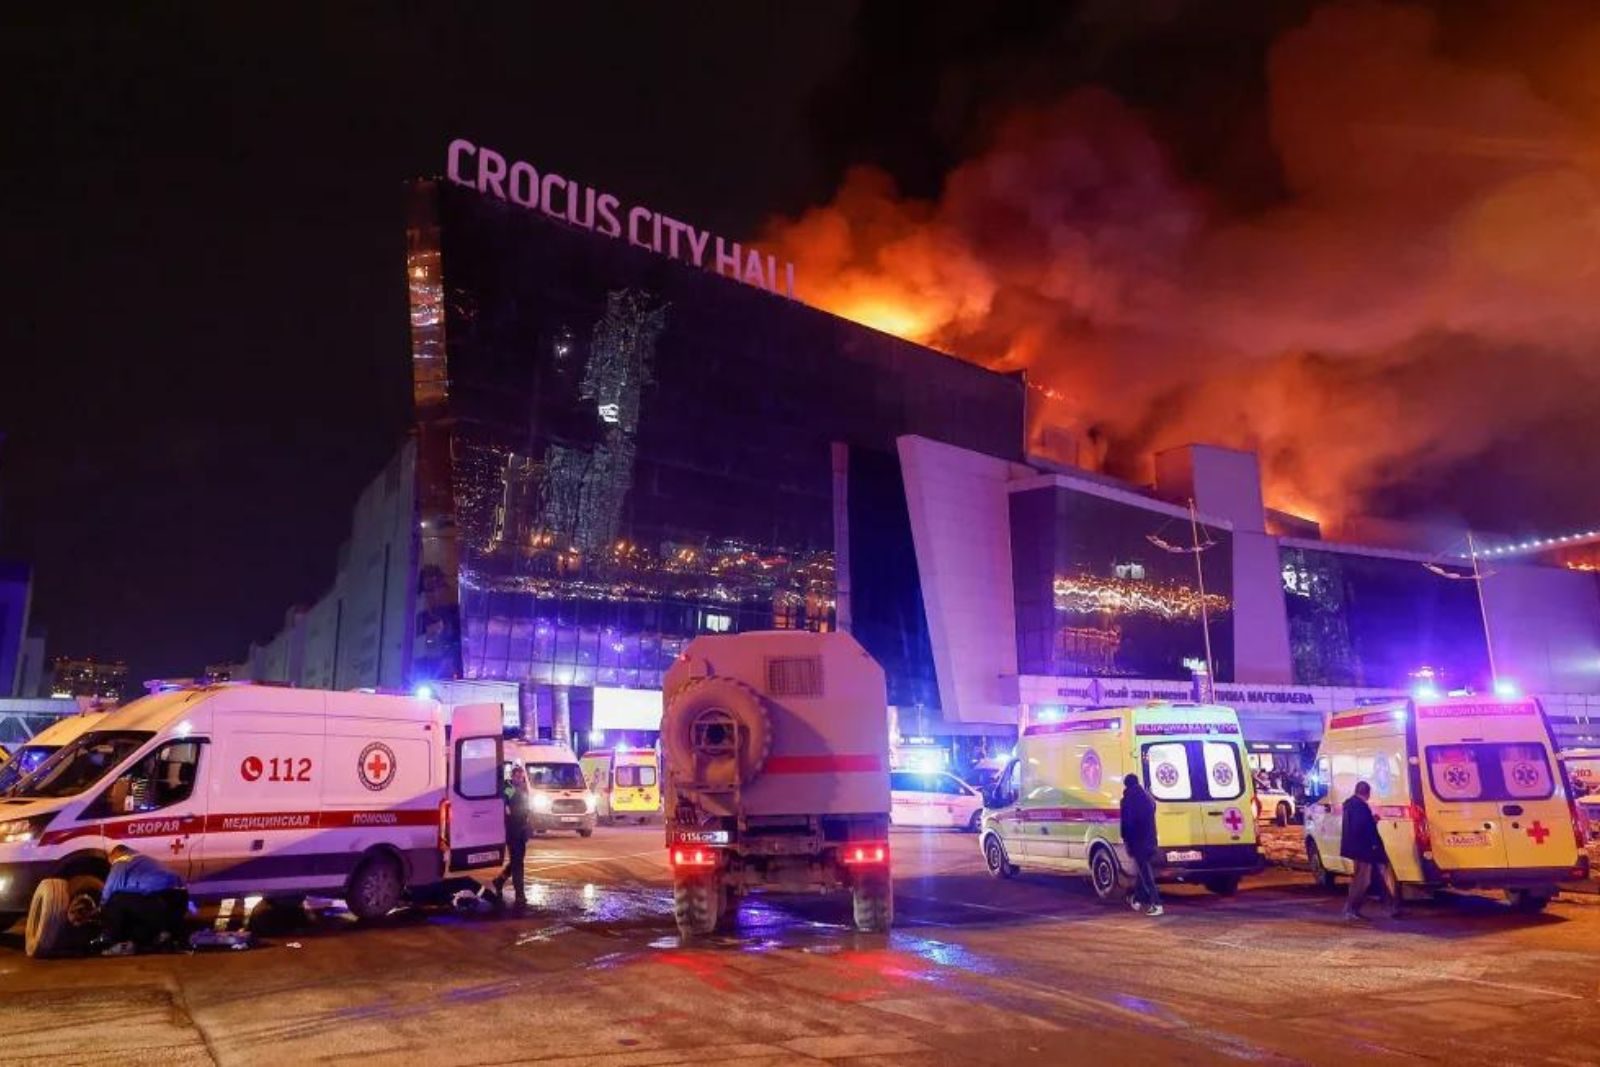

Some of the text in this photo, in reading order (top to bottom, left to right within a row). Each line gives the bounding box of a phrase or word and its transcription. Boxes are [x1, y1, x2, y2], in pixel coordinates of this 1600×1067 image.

[447, 138, 620, 238] CROCUS
[628, 205, 709, 266] CITY
[1247, 691, 1315, 704] МАГОМАЕВА
[268, 757, 312, 782] 112
[127, 812, 397, 835] СКОРАЯ МЕДИЦИНСКАЯ ПОМОЩЬ
